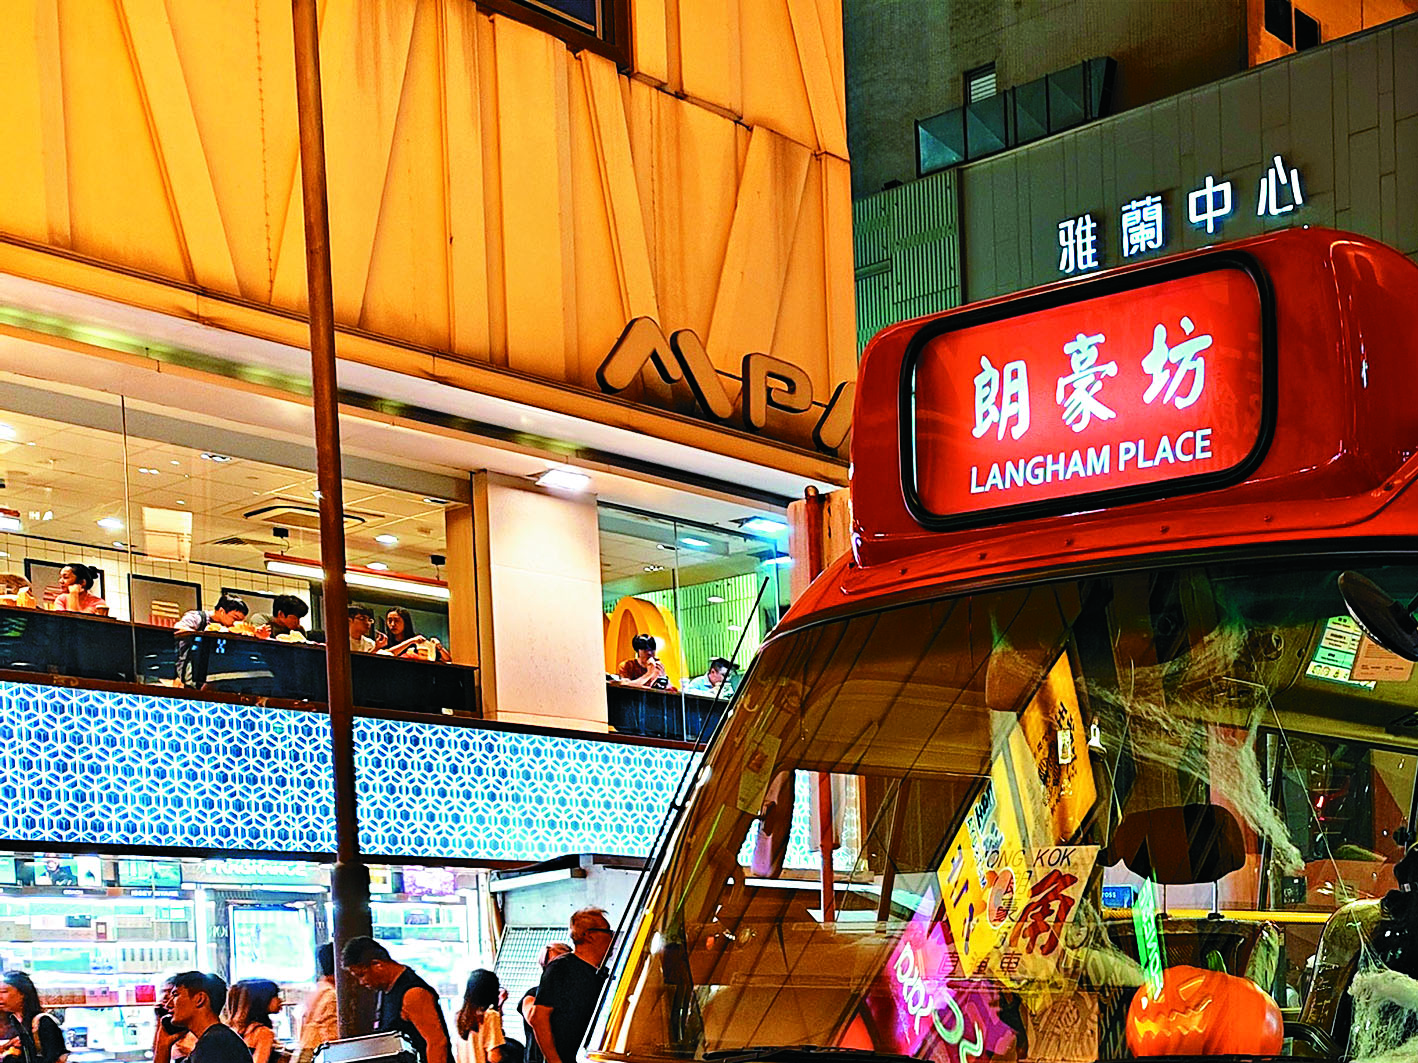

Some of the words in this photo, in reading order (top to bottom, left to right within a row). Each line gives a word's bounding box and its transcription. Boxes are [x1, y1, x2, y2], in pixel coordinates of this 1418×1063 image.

[1057, 154, 1303, 274] 雅蘭中心
[971, 315, 1213, 442] 朗豪坊
[970, 444, 1110, 494] LANGHAM
[1118, 429, 1212, 471] PLACE
[978, 849, 1026, 868] ONG
[1032, 848, 1076, 867] KOK
